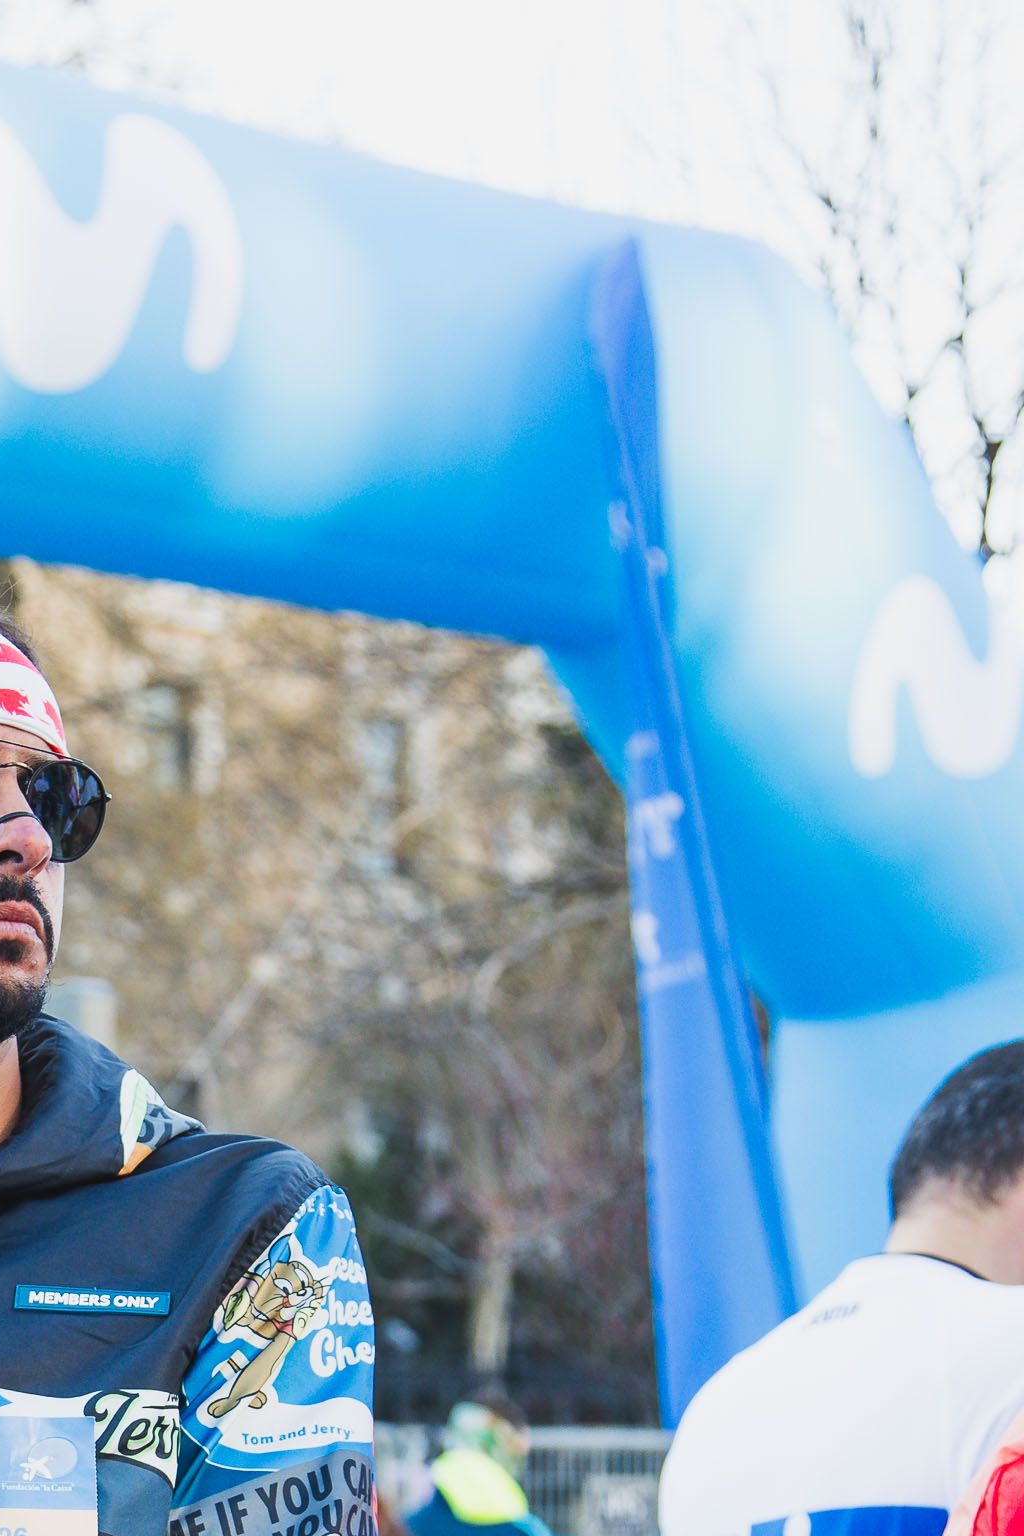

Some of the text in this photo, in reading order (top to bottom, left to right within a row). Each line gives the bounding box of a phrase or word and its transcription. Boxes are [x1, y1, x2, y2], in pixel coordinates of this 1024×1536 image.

[28, 1290, 159, 1308] MEMBERS ONLY
[241, 1424, 351, 1445] Tom and Jerry
[255, 1464, 333, 1525] YOU
